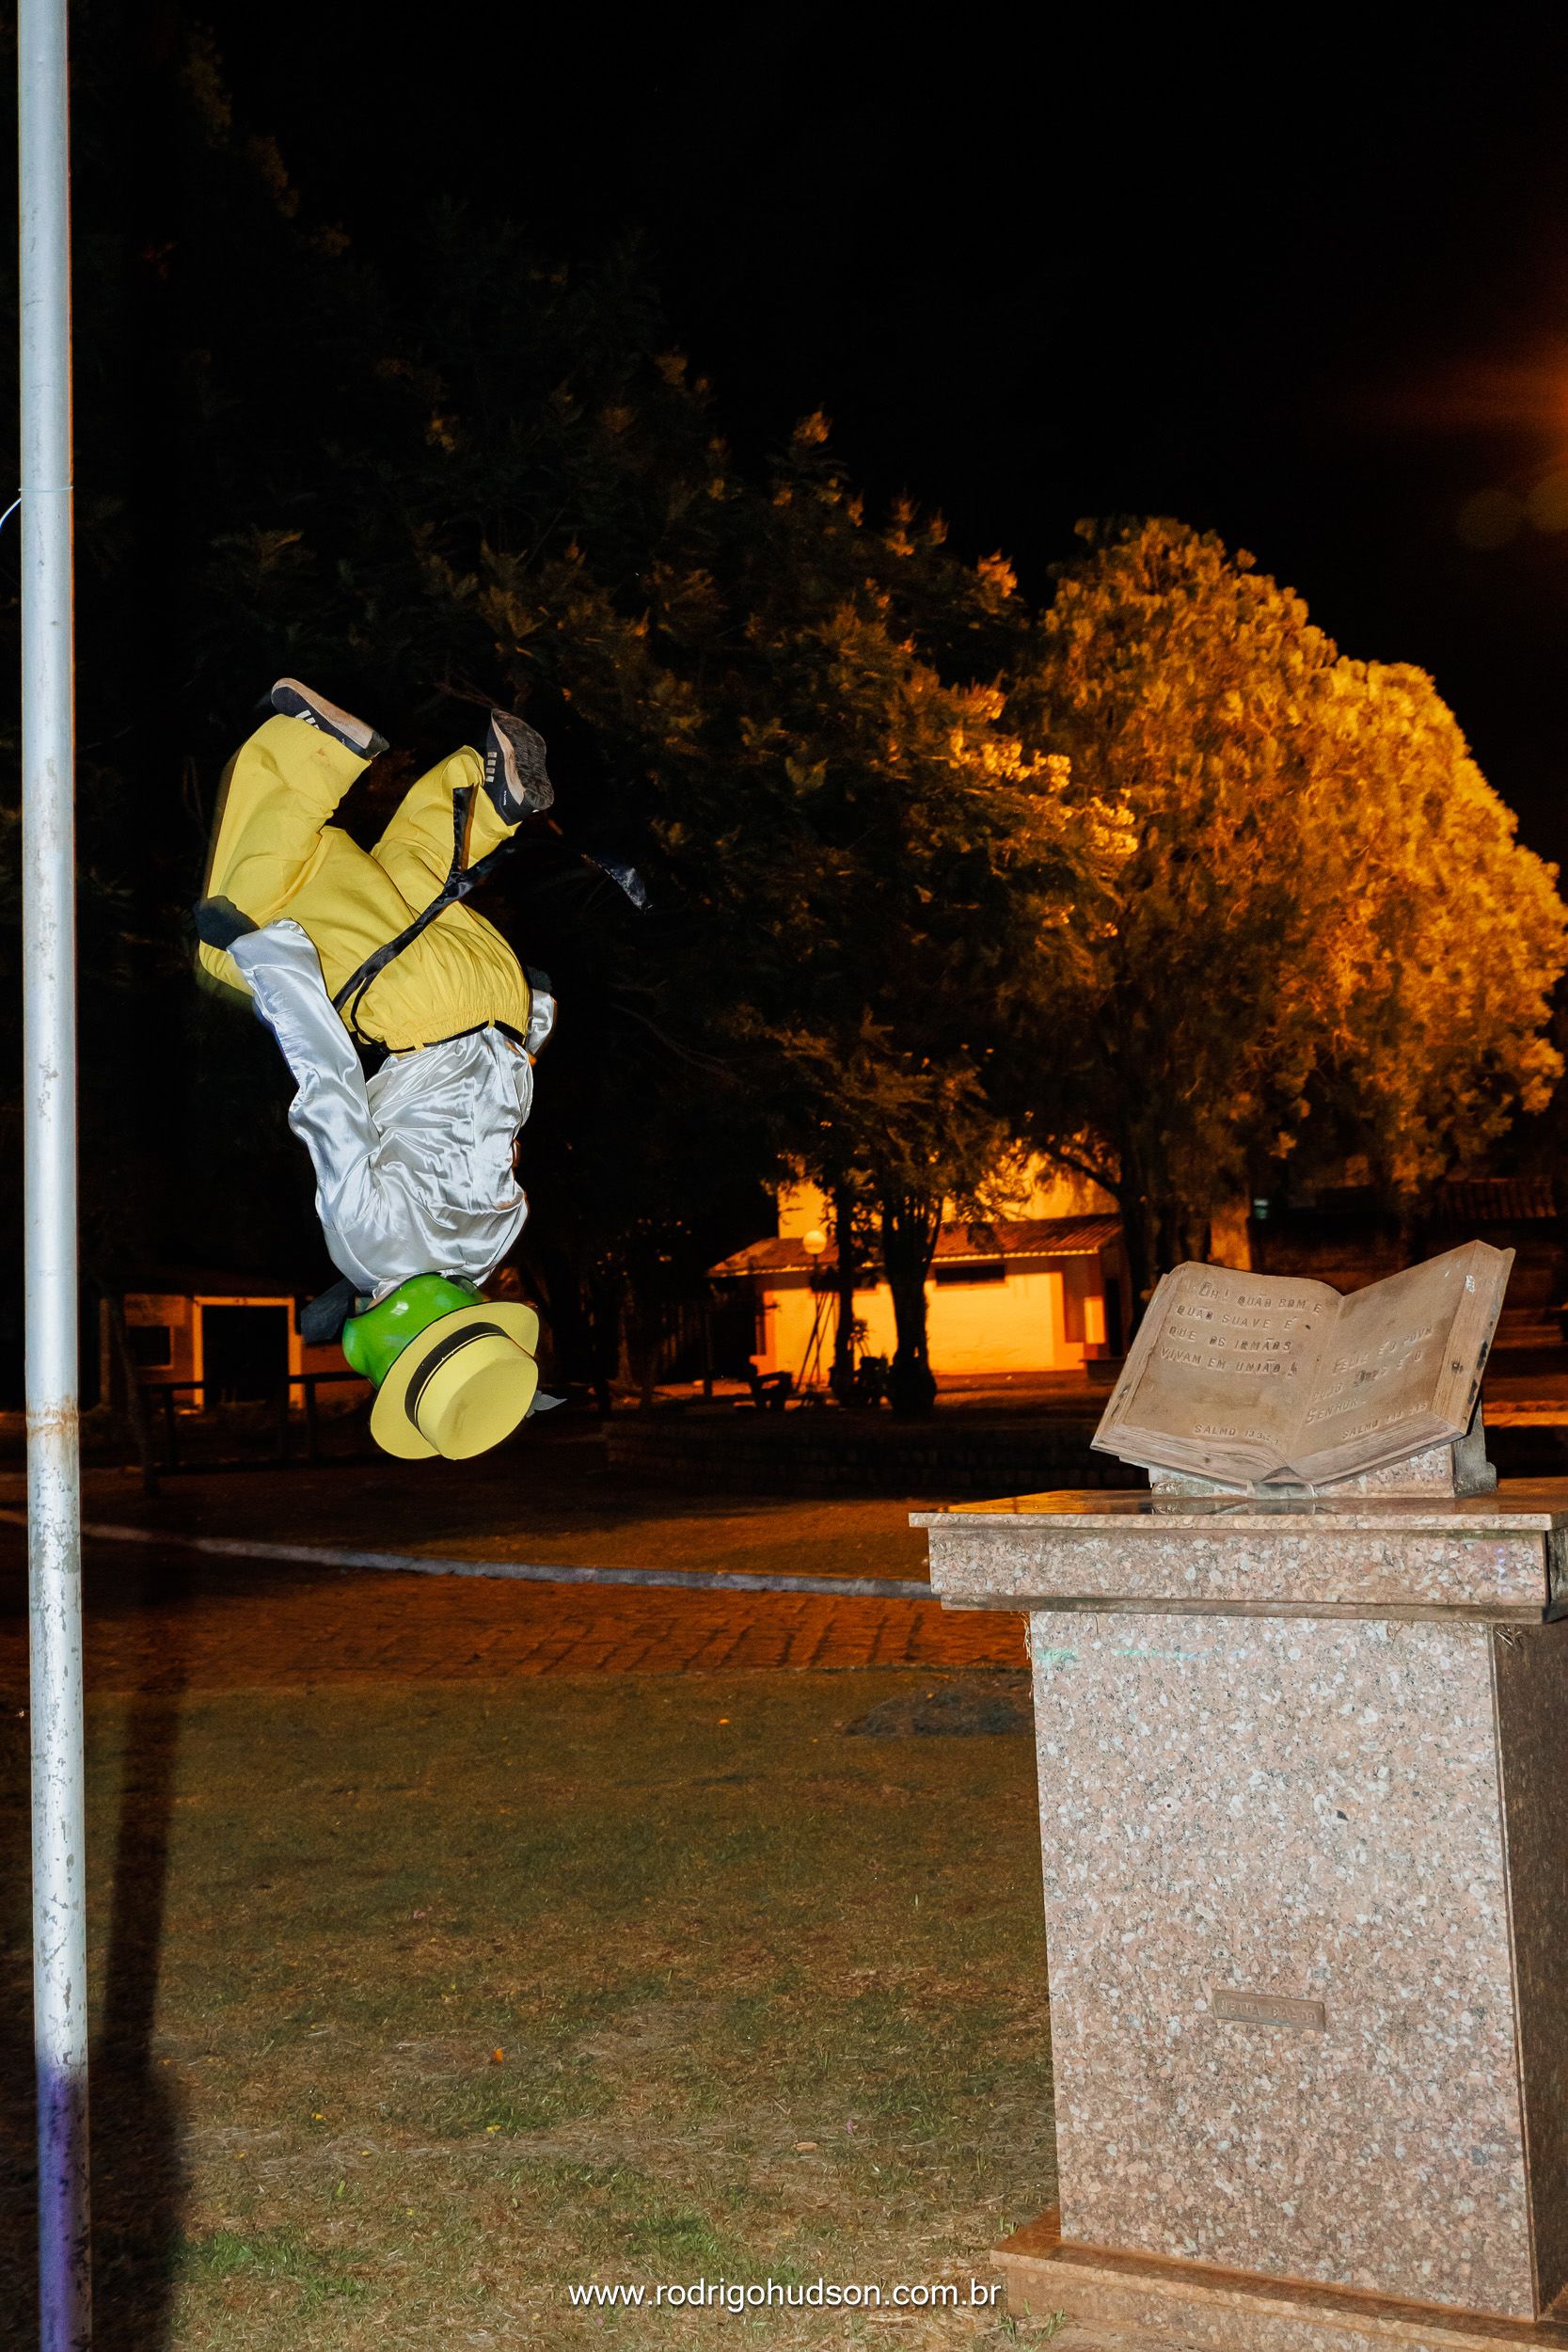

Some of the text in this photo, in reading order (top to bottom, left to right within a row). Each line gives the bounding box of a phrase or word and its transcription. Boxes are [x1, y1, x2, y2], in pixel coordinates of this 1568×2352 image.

[1221, 1313, 1272, 1329] SUAVE
[1168, 1325, 1197, 1342] QUE
[1234, 1337, 1293, 1352] IRMÃOS
[1161, 1346, 1202, 1366] VIVAM
[1208, 1358, 1227, 1370] EM
[1195, 1423, 1236, 1437] SALMO
